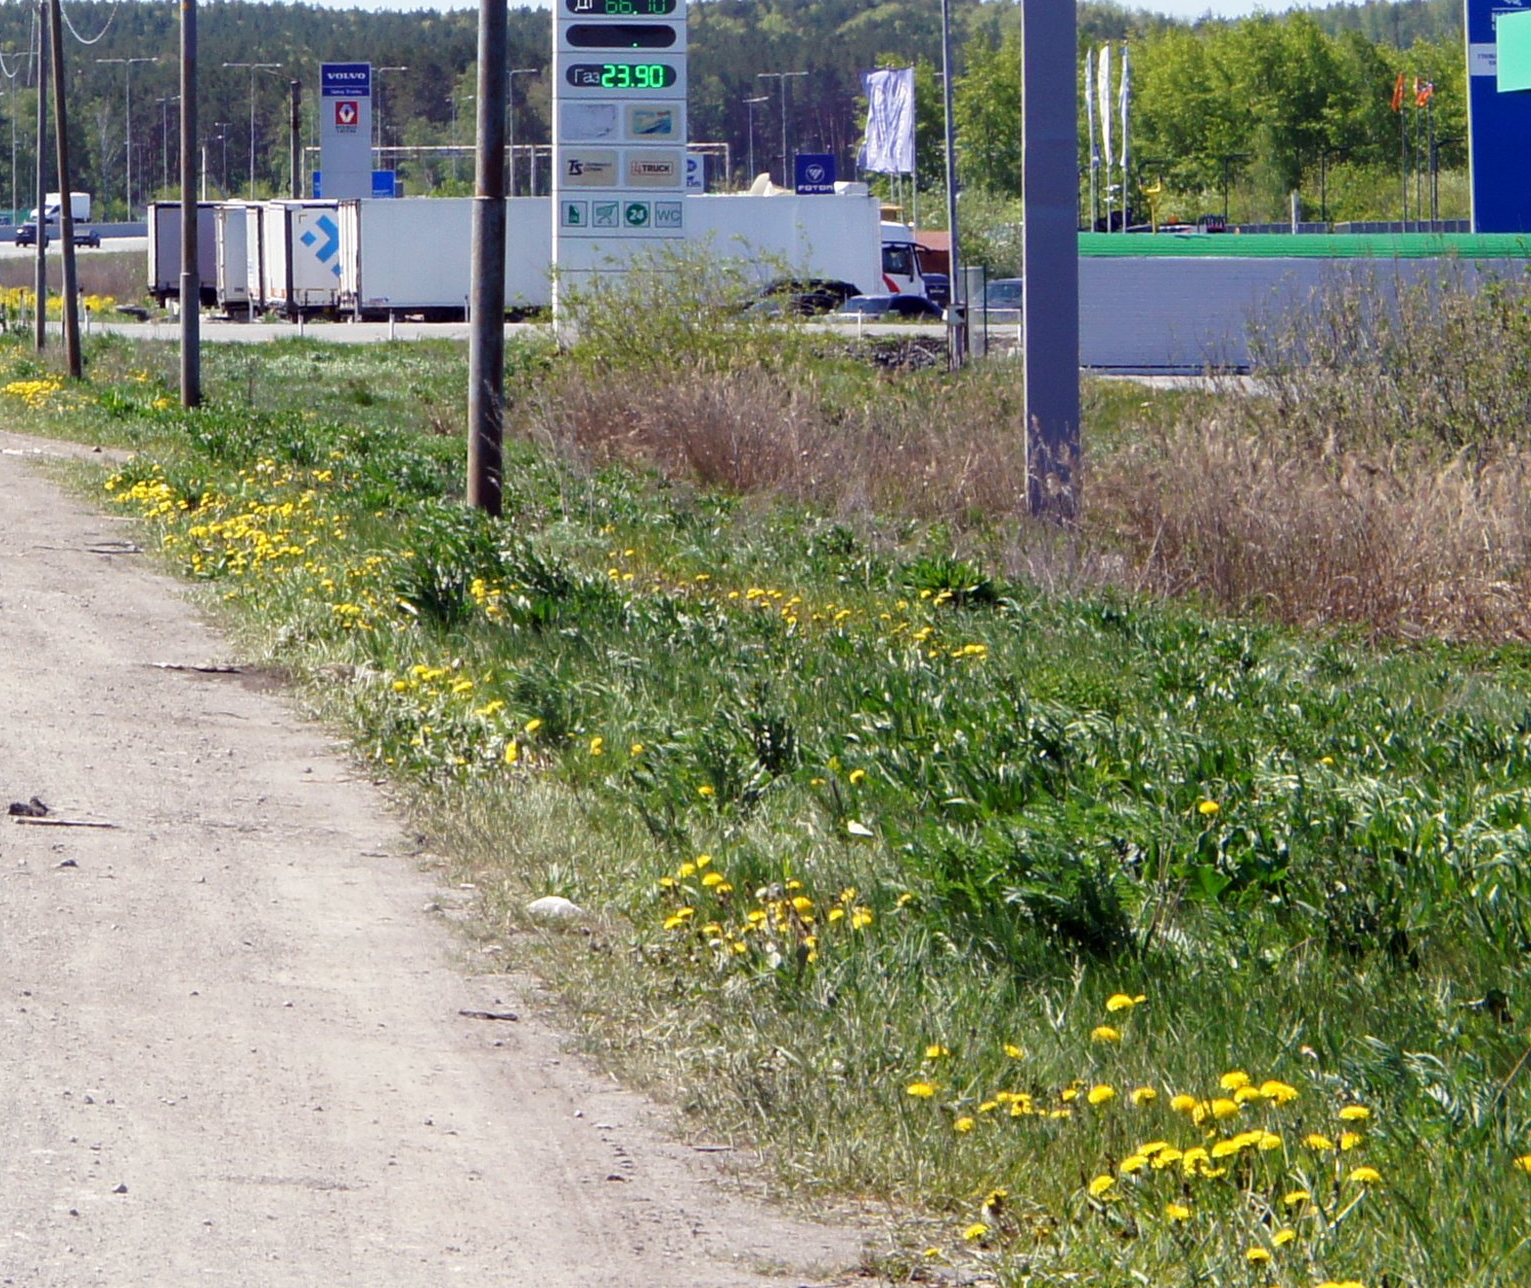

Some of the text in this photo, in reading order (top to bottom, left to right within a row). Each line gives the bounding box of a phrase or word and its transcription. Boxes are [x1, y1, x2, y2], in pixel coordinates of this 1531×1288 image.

[327, 72, 366, 80] VOLVO
[574, 64, 664, 88] Газ 23.90
[797, 184, 834, 192] FOTON
[657, 209, 681, 222] WC
